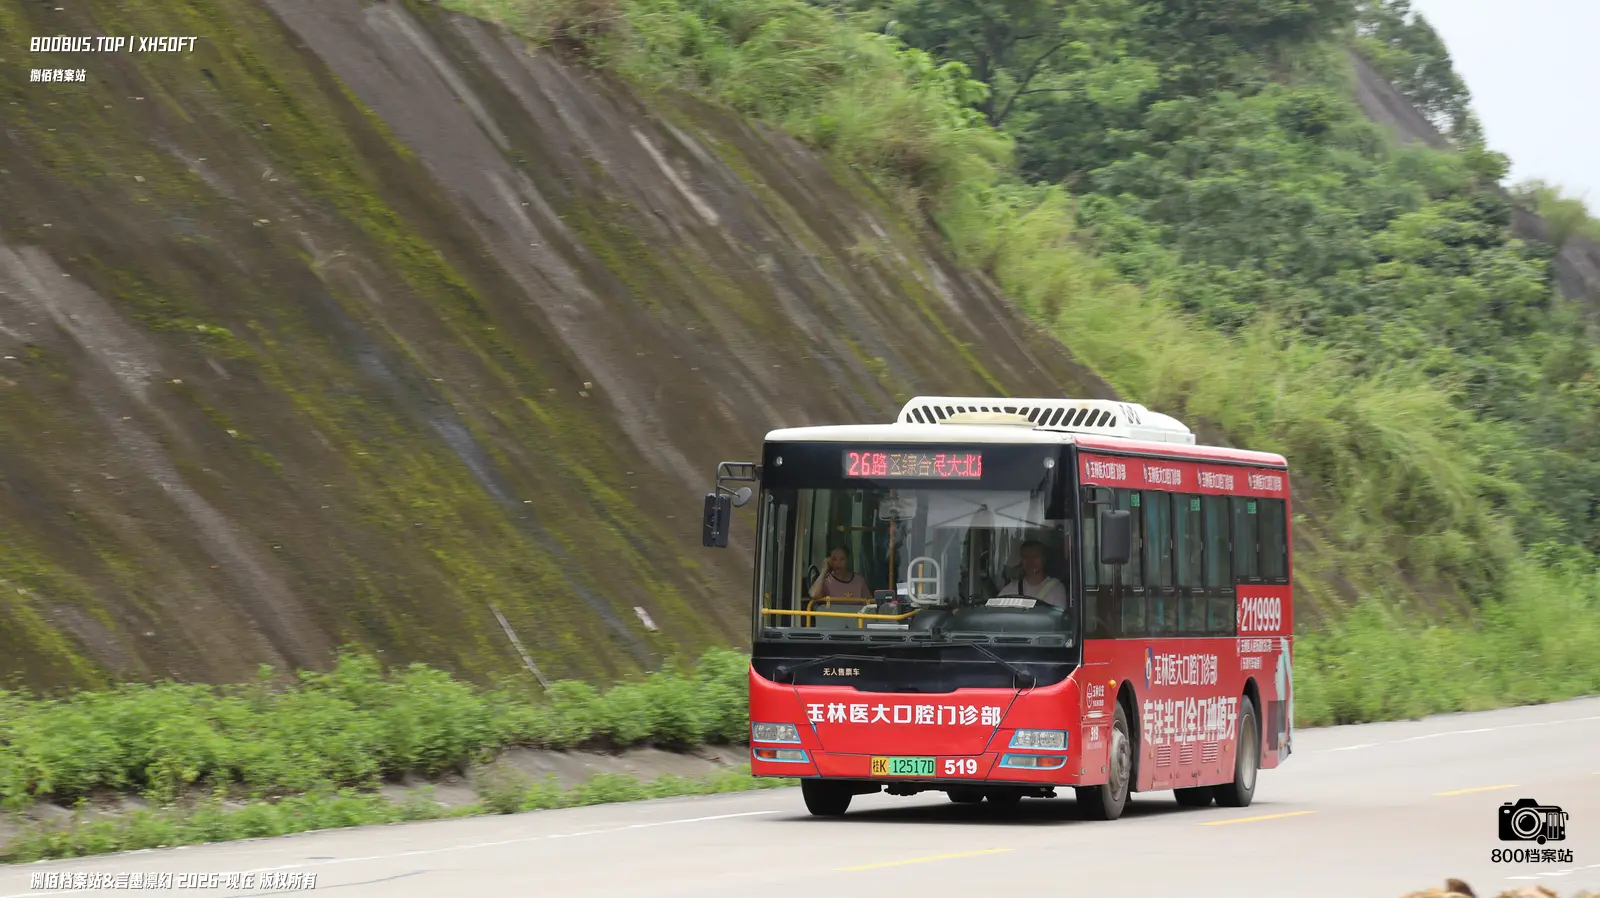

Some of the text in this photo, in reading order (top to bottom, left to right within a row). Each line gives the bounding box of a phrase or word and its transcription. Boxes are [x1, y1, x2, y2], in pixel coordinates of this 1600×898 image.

[849, 452, 888, 476] 26路
[1241, 597, 1282, 632] 2119999
[823, 667, 860, 676] 无人售票车
[1154, 653, 1218, 686] 玉林医大口腔门诊部
[806, 702, 1002, 727] 玉林医大口腔门诊部
[1143, 696, 1238, 746] 专注半口/全口种植牙
[893, 759, 935, 774] 12517D
[944, 759, 978, 775] 519
